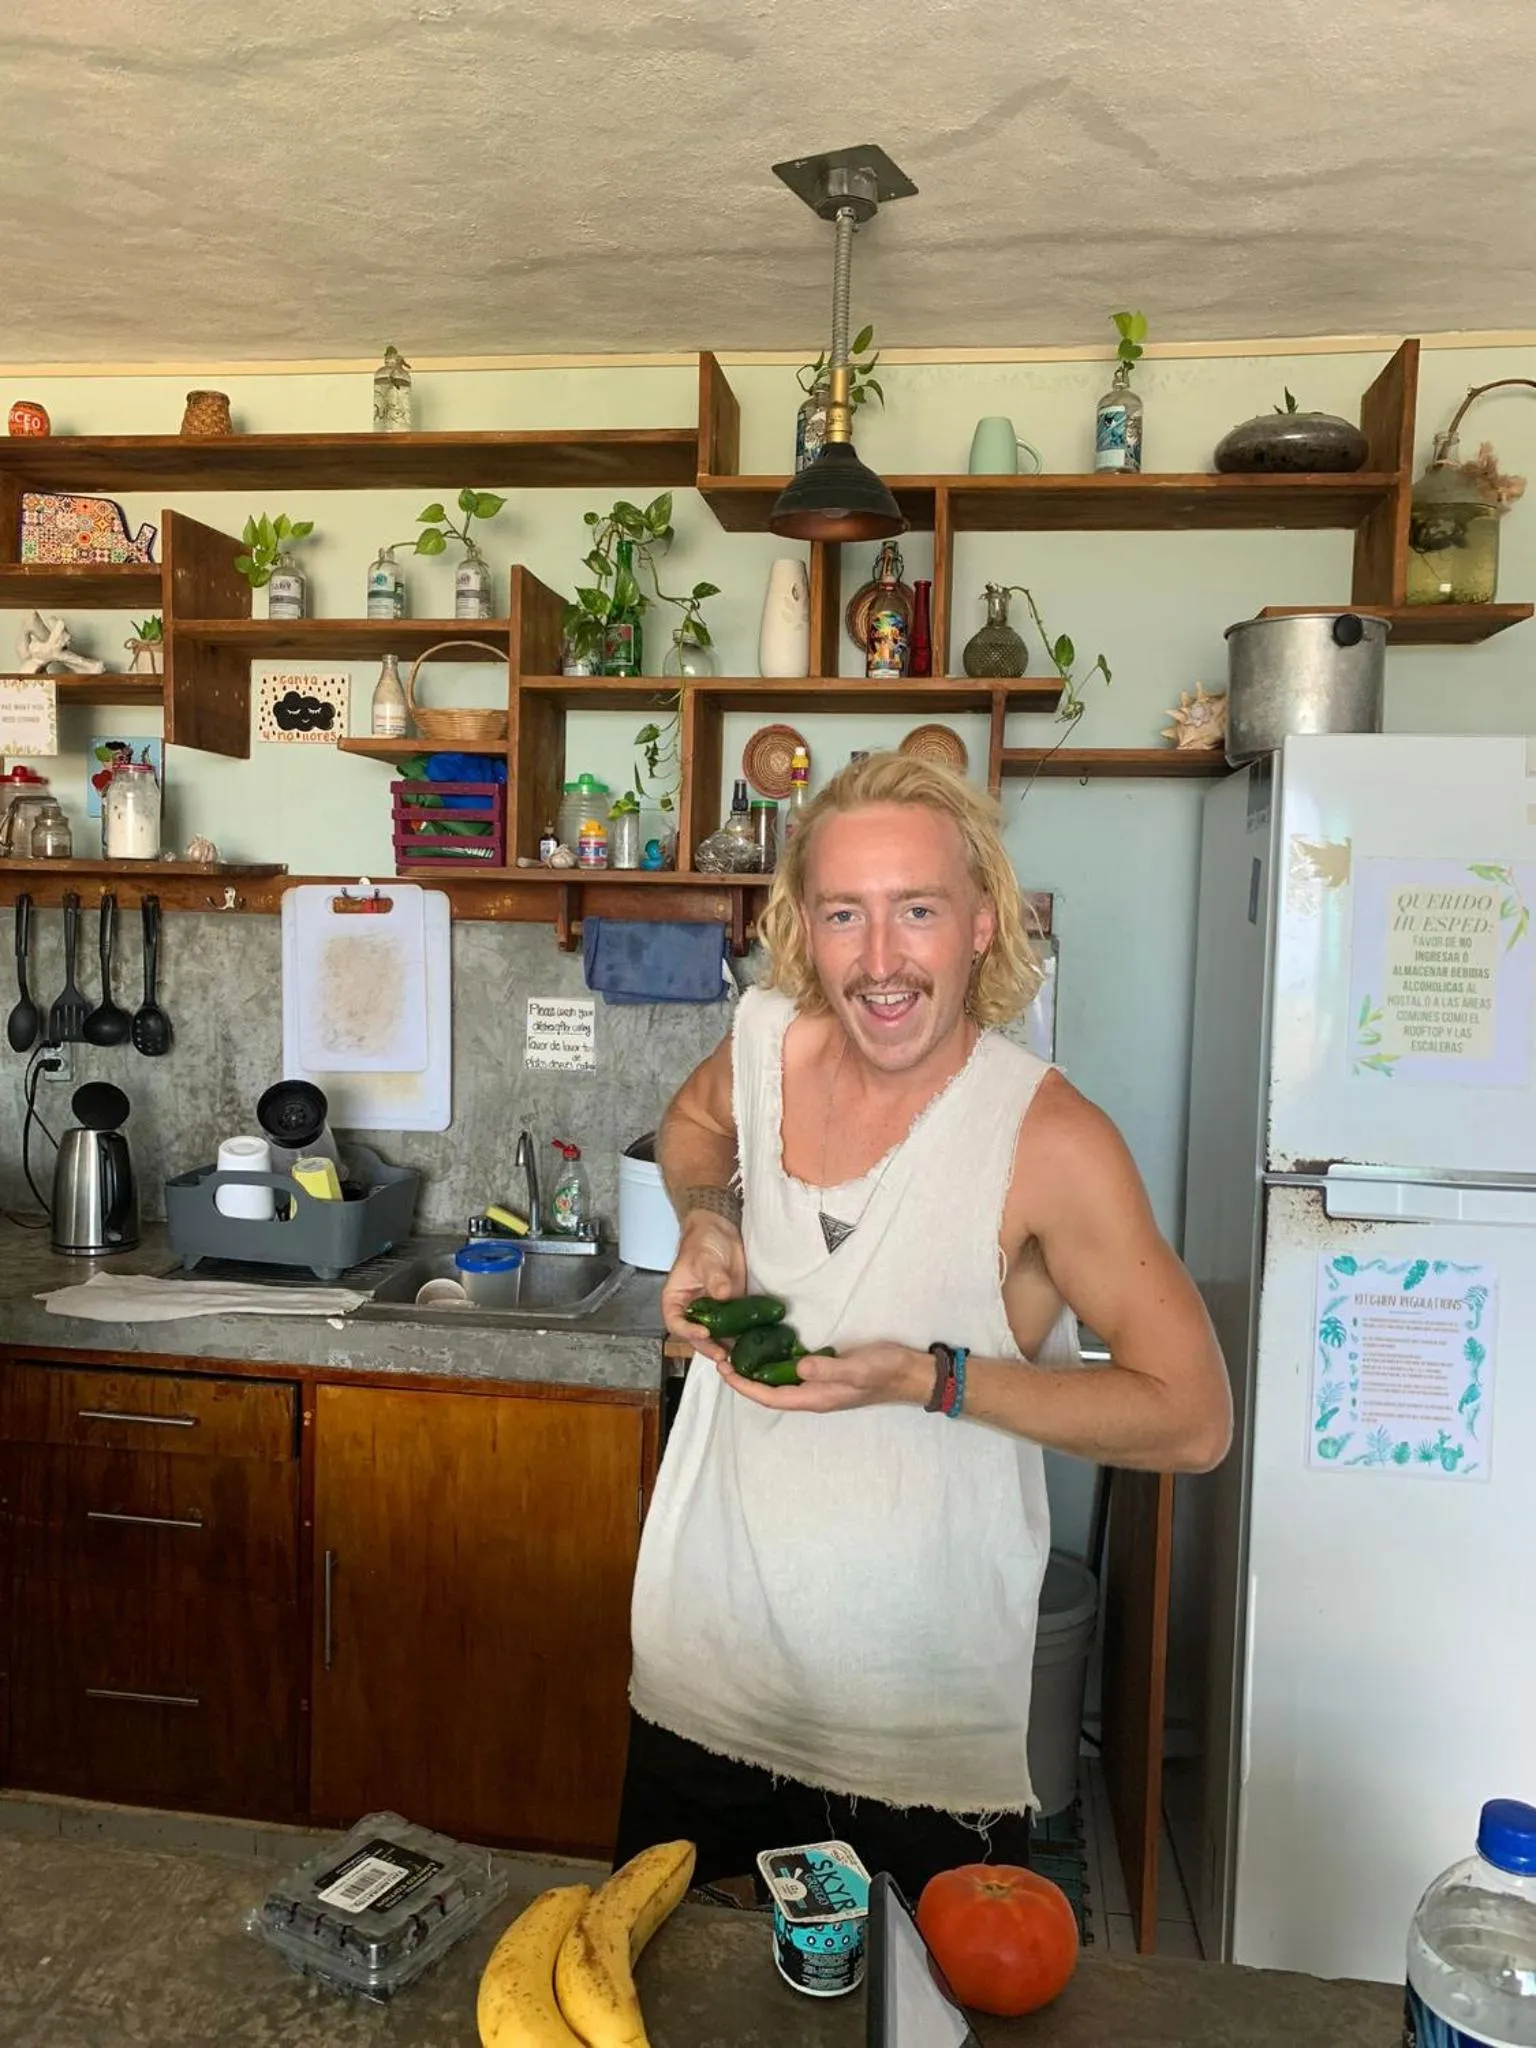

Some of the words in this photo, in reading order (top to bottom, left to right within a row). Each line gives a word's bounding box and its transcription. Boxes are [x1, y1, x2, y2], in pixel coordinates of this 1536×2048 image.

[279, 675, 318, 685] canta
[1397, 893, 1493, 913] QUERIDO
[1413, 935, 1442, 947] FAVOR
[1445, 936, 1456, 948] DE
[1459, 936, 1473, 948] NO
[1415, 950, 1460, 962] INGRESAR
[1392, 965, 1448, 977] ALMACENAR
[1450, 967, 1490, 979] BEBIDAS
[1466, 982, 1477, 994] AL
[1387, 995, 1421, 1007] HOSTAL
[1433, 996, 1440, 1008] A
[1441, 997, 1462, 1009] LAS
[1396, 1010, 1440, 1023] COMUNES
[1441, 1011, 1469, 1023] COMO
[1469, 1012, 1480, 1024] EL
[1403, 1025, 1444, 1038] ROOFTOP
[1446, 1026, 1453, 1037] Y
[1454, 1027, 1473, 1038] LAS
[1411, 1039, 1463, 1053] ESCALERAS
[1354, 1293, 1396, 1306] KITCHEN
[1400, 1295, 1463, 1311] REGULATIONS
[812, 1859, 857, 1914] SKYR
